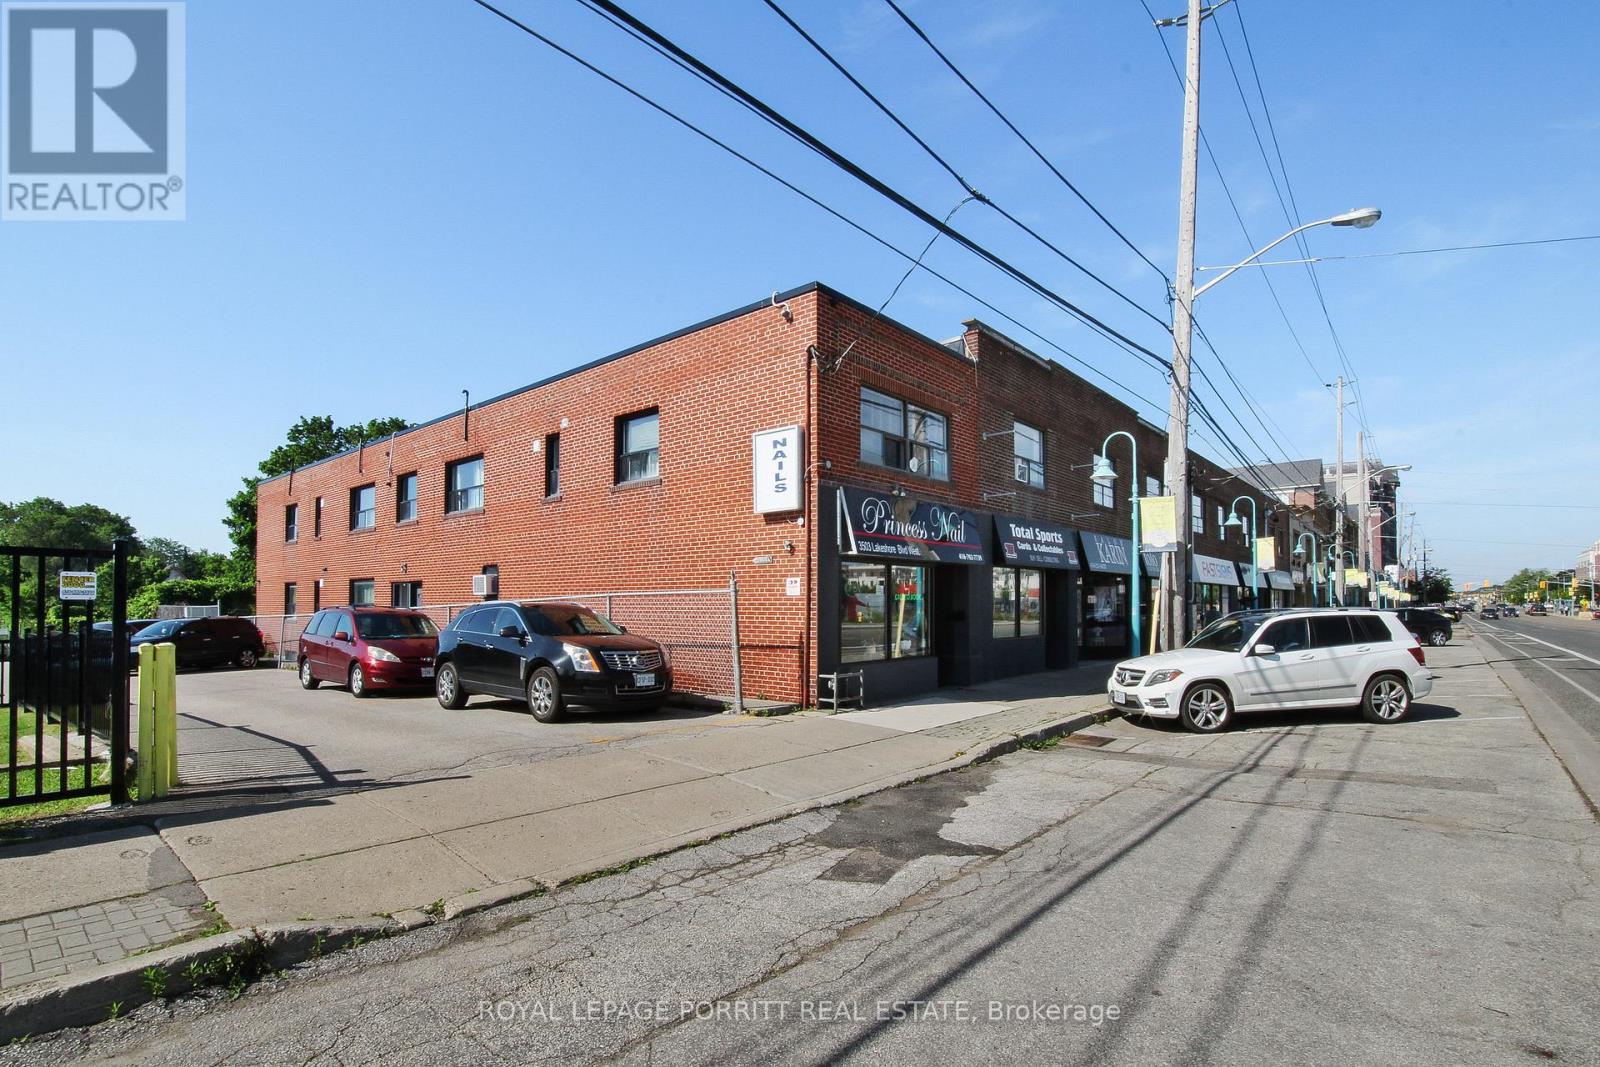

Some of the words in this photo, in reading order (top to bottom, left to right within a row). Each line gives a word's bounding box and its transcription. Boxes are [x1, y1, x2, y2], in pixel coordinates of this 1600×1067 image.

[772, 437, 788, 493] NAILS
[861, 497, 928, 539] Princess
[929, 506, 967, 543] Nail
[1009, 523, 1035, 540] Total
[1035, 528, 1064, 544] Sports
[858, 541, 872, 552] 3503
[872, 542, 897, 554] Lakeshore
[897, 544, 908, 555] Blvd
[1016, 541, 1032, 551] Cards
